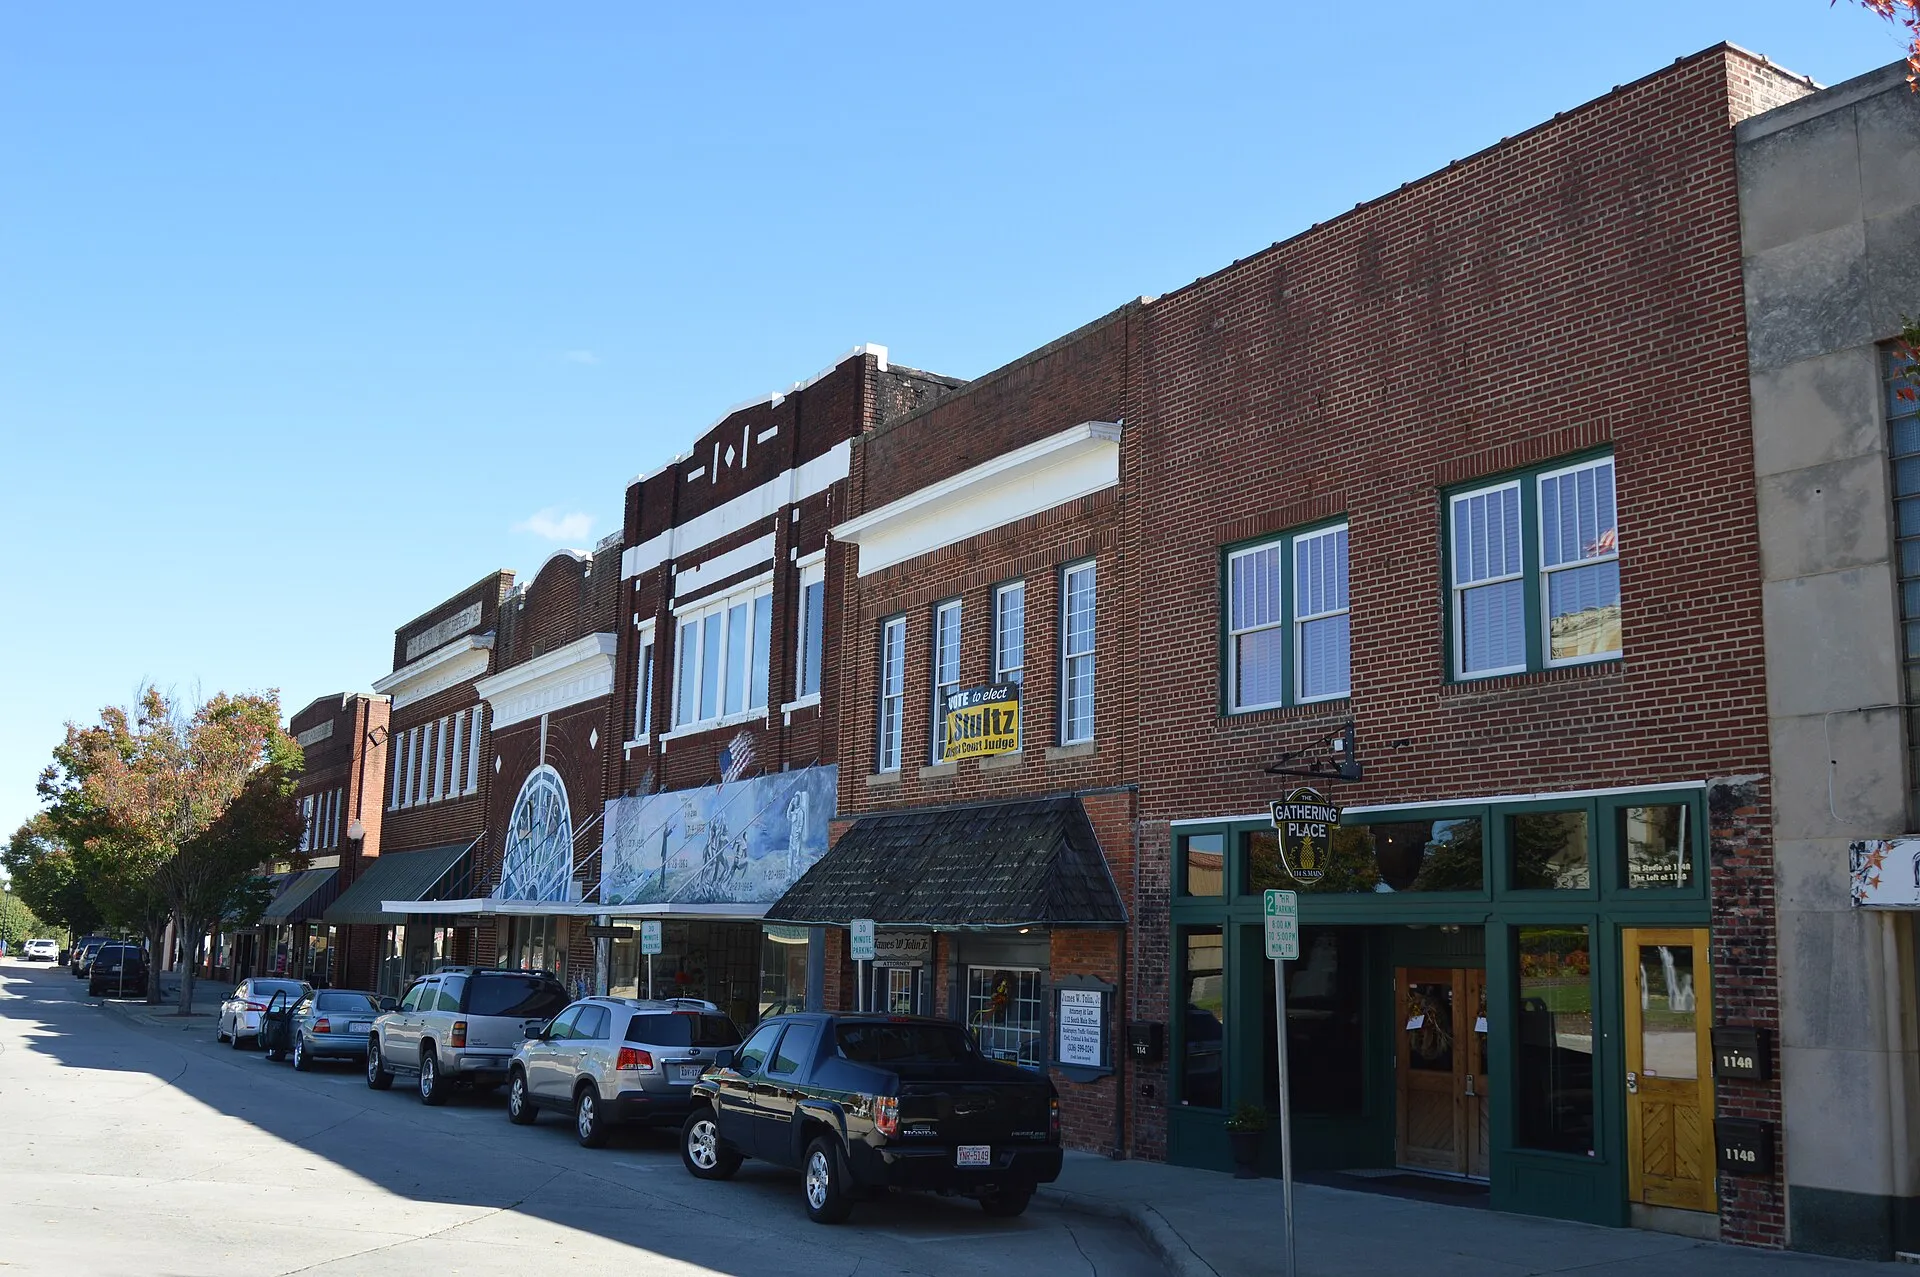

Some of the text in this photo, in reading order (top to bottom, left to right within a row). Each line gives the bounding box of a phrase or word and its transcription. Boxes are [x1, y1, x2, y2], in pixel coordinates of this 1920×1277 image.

[948, 686, 1007, 710] VOTE to elect
[954, 707, 1015, 741] Stultz
[962, 740, 982, 753] Court
[984, 738, 1014, 750] Judge
[1275, 805, 1337, 822] GATHERING
[1288, 823, 1326, 838] PLACE
[1642, 864, 1662, 872] Studio
[1266, 895, 1274, 912] 2
[1281, 895, 1290, 904] HR
[1275, 905, 1296, 914] PARKING
[859, 924, 866, 933] 30
[1284, 920, 1292, 929] AM
[853, 935, 872, 944] MINUTE
[1268, 932, 1274, 940] TO
[873, 938, 895, 949] James
[895, 938, 904, 949] W
[853, 946, 873, 955] PARKING
[1061, 992, 1075, 1003] James
[1069, 1008, 1082, 1016] Attorney
[1086, 1008, 1094, 1016] Law
[1088, 1017, 1097, 1025] Street
[1136, 1046, 1146, 1054] 114
[1722, 1056, 1753, 1069] 114A
[958, 1150, 989, 1161] YNR-5149
[1725, 1148, 1756, 1162] 114B
